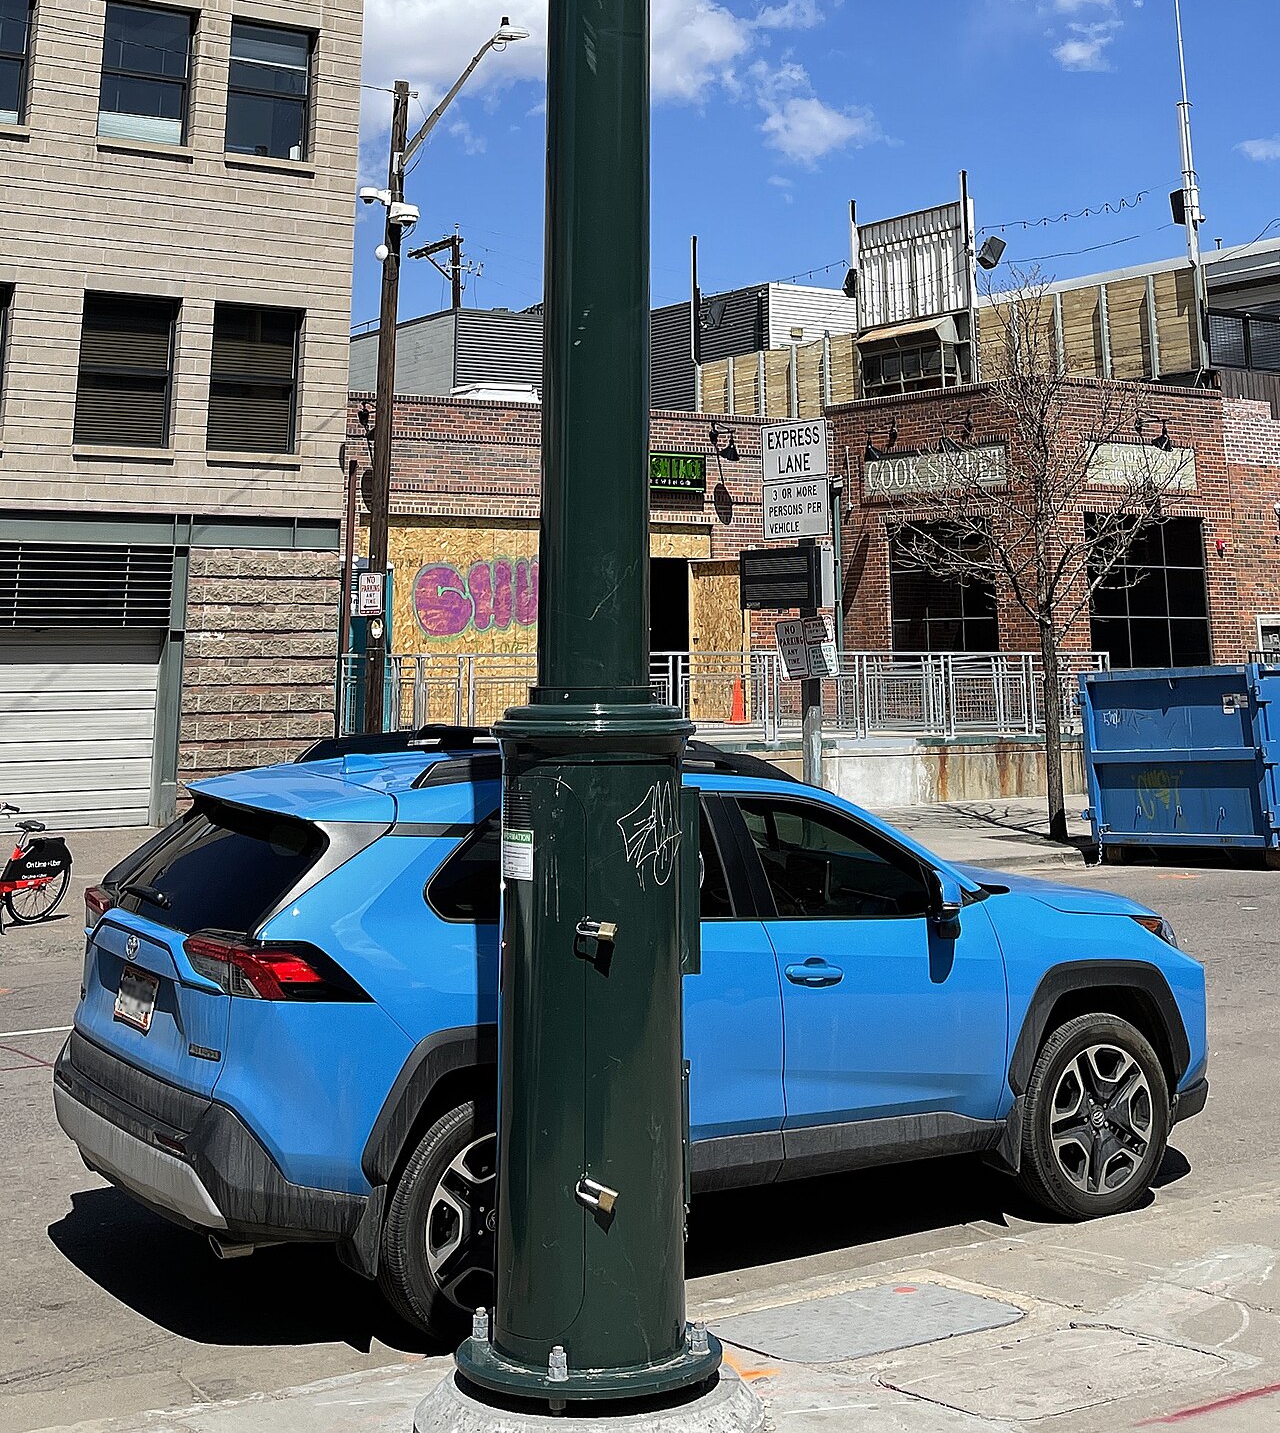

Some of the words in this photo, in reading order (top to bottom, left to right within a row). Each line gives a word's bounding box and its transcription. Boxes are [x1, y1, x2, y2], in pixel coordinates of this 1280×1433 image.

[767, 426, 820, 450] EXPRESS
[778, 453, 811, 474] LANE
[868, 456, 923, 489] COOK
[772, 489, 778, 501] 3
[782, 487, 792, 499] OR
[796, 485, 817, 498] MORE
[769, 504, 803, 518] PERSONS
[807, 502, 822, 514] PER
[769, 521, 800, 534] VEHICLE
[366, 576, 376, 584] NO
[361, 584, 380, 592] PARKING
[784, 625, 795, 635] NO
[780, 636, 803, 647] PARKING
